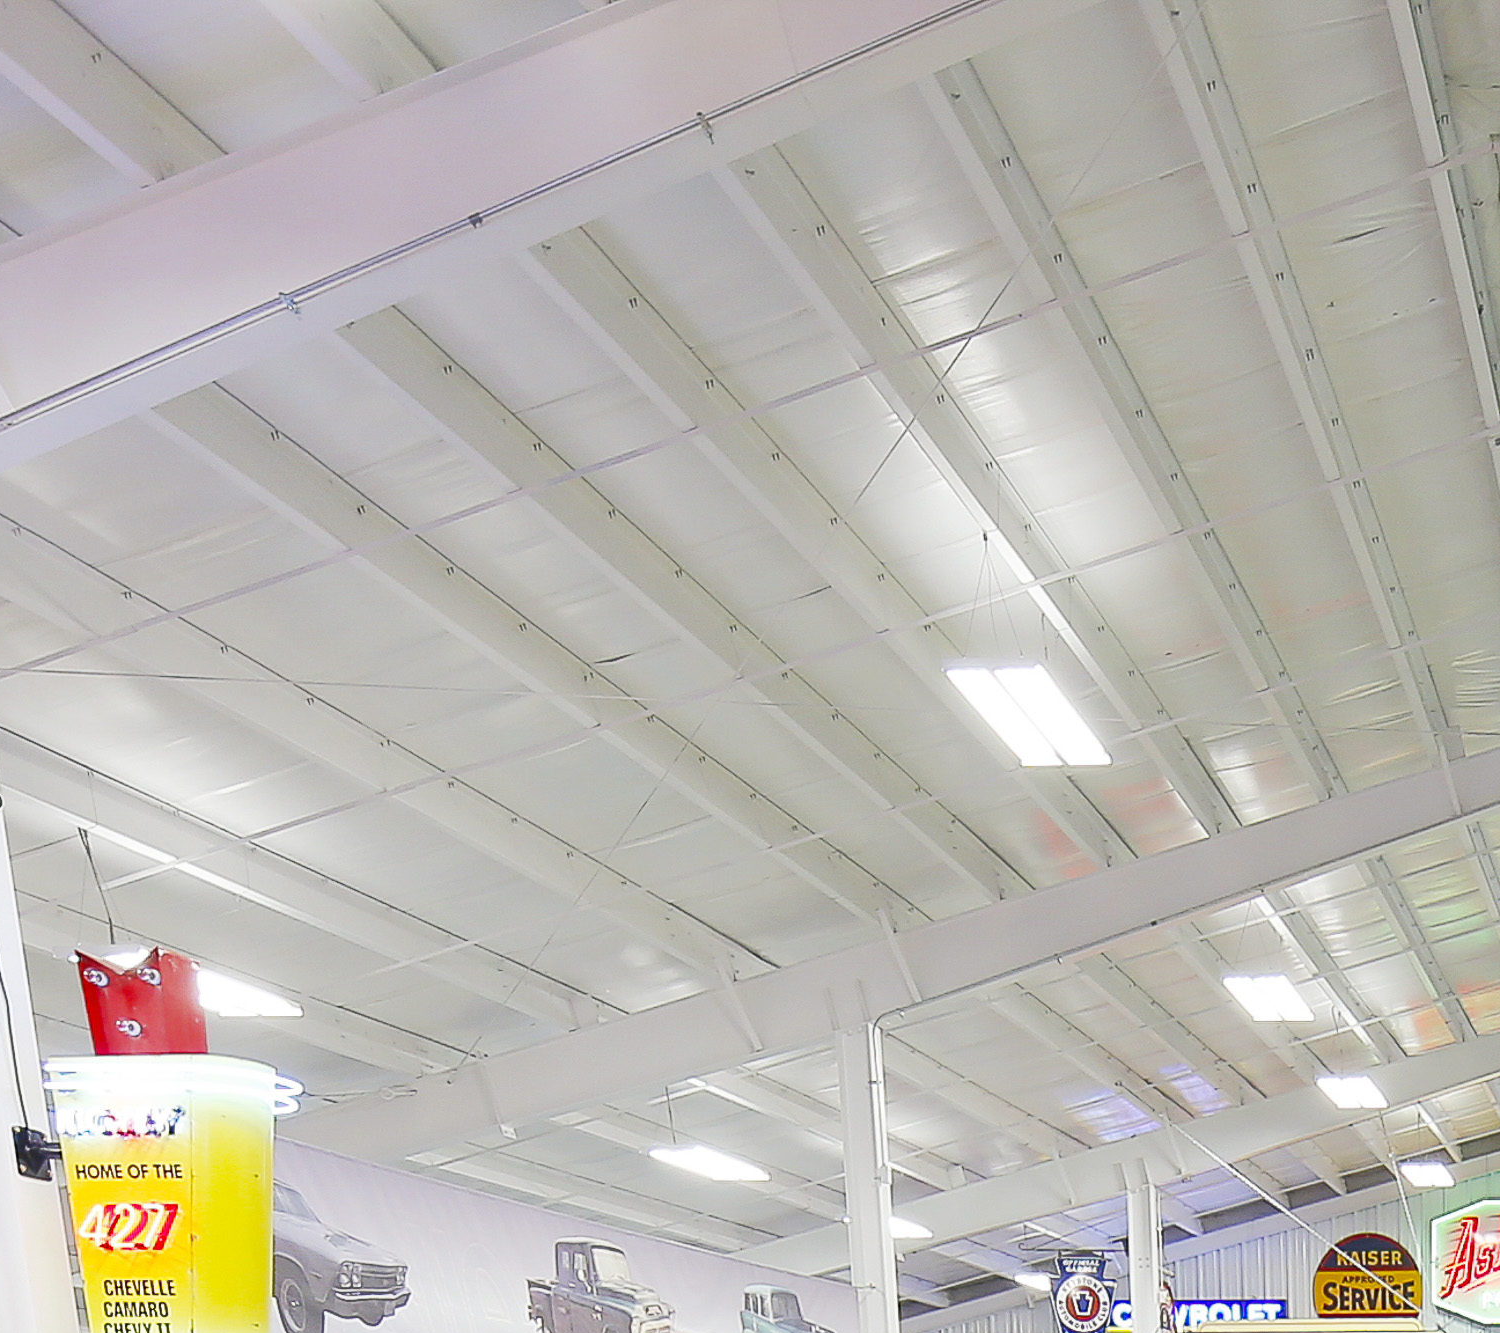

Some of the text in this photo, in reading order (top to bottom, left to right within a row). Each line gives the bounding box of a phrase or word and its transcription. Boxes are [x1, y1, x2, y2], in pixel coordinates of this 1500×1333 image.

[76, 1164, 183, 1179] HOME OF THE
[78, 1203, 178, 1251] 427
[1337, 1250, 1403, 1266] KAISER
[103, 1279, 176, 1298] CHEVELLE
[1323, 1280, 1415, 1311] SERVICE
[103, 1300, 169, 1318] CAMARO
